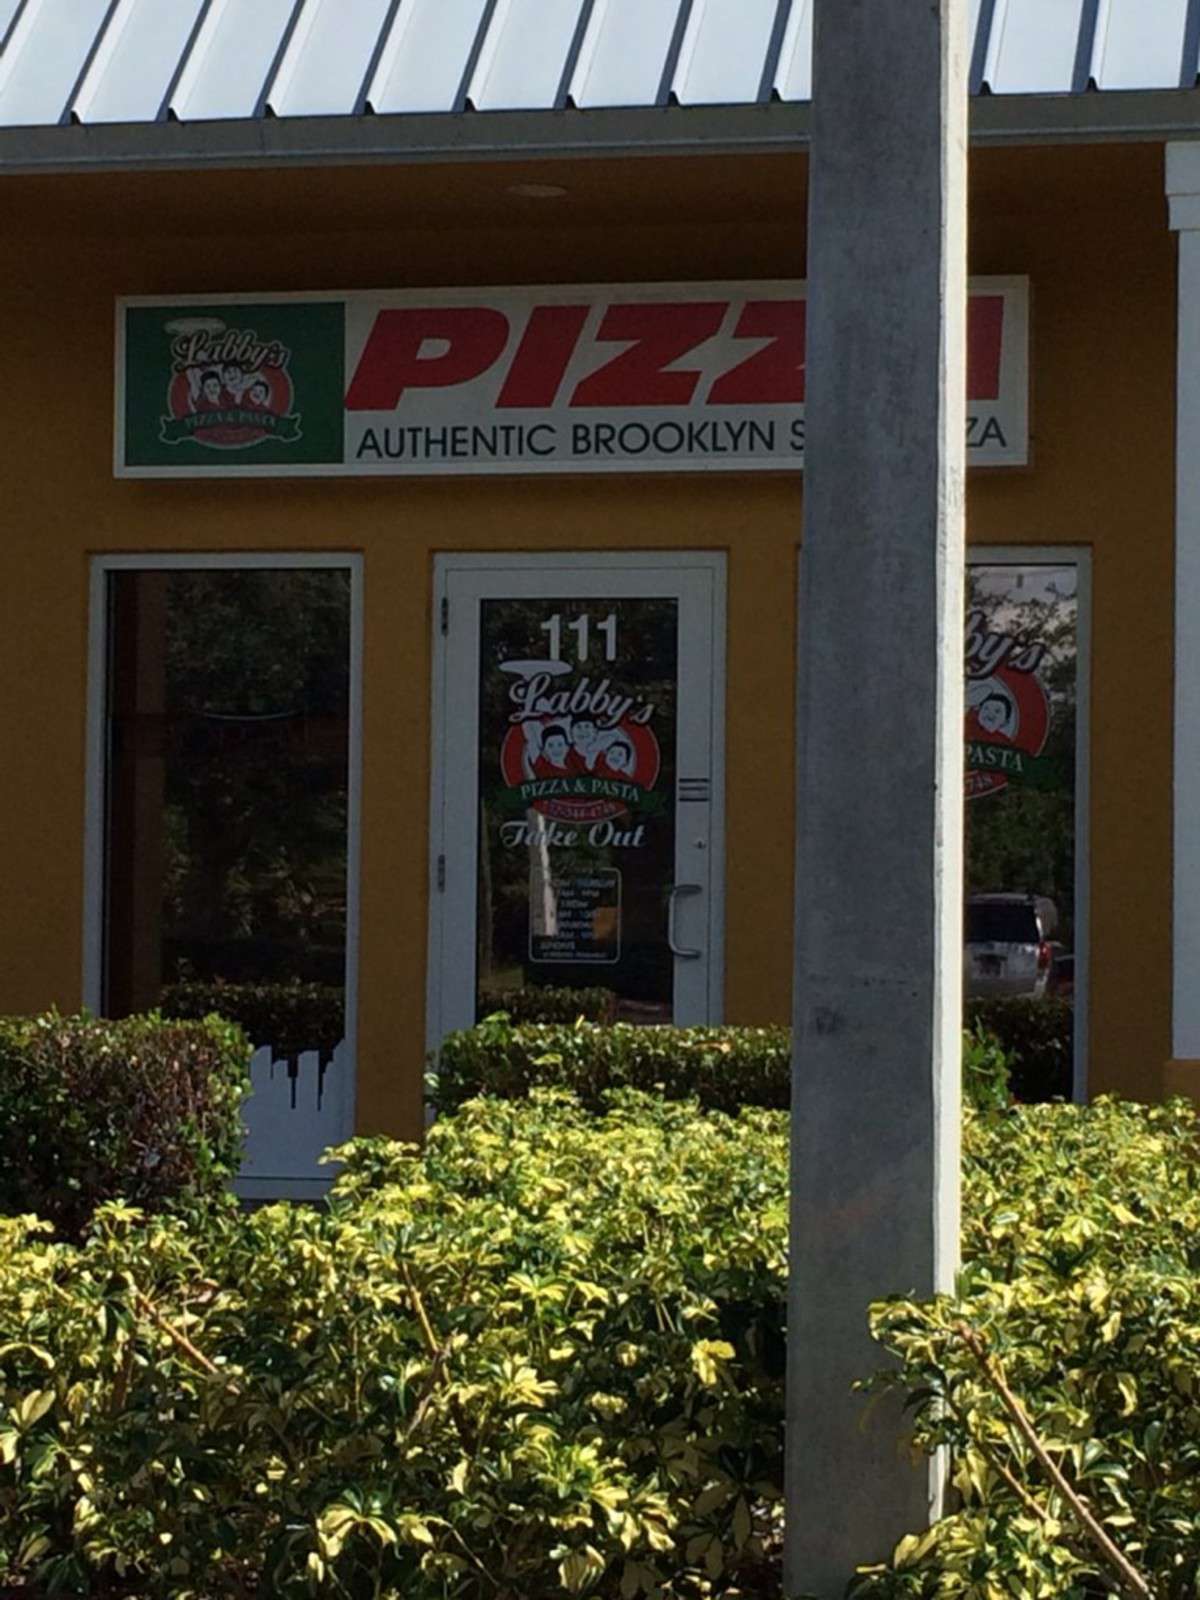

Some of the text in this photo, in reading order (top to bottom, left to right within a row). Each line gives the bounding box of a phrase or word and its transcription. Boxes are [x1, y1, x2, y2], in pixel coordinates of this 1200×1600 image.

[173, 329, 288, 373] Labby's
[345, 296, 1004, 411] PIZZ
[356, 425, 558, 459] AUTHENTIC
[571, 420, 775, 456] BROOKLYN
[540, 613, 617, 662] 111
[508, 672, 656, 727] Labby's
[520, 778, 640, 801] PIZZA & PASTA
[500, 820, 646, 848] Take Out
